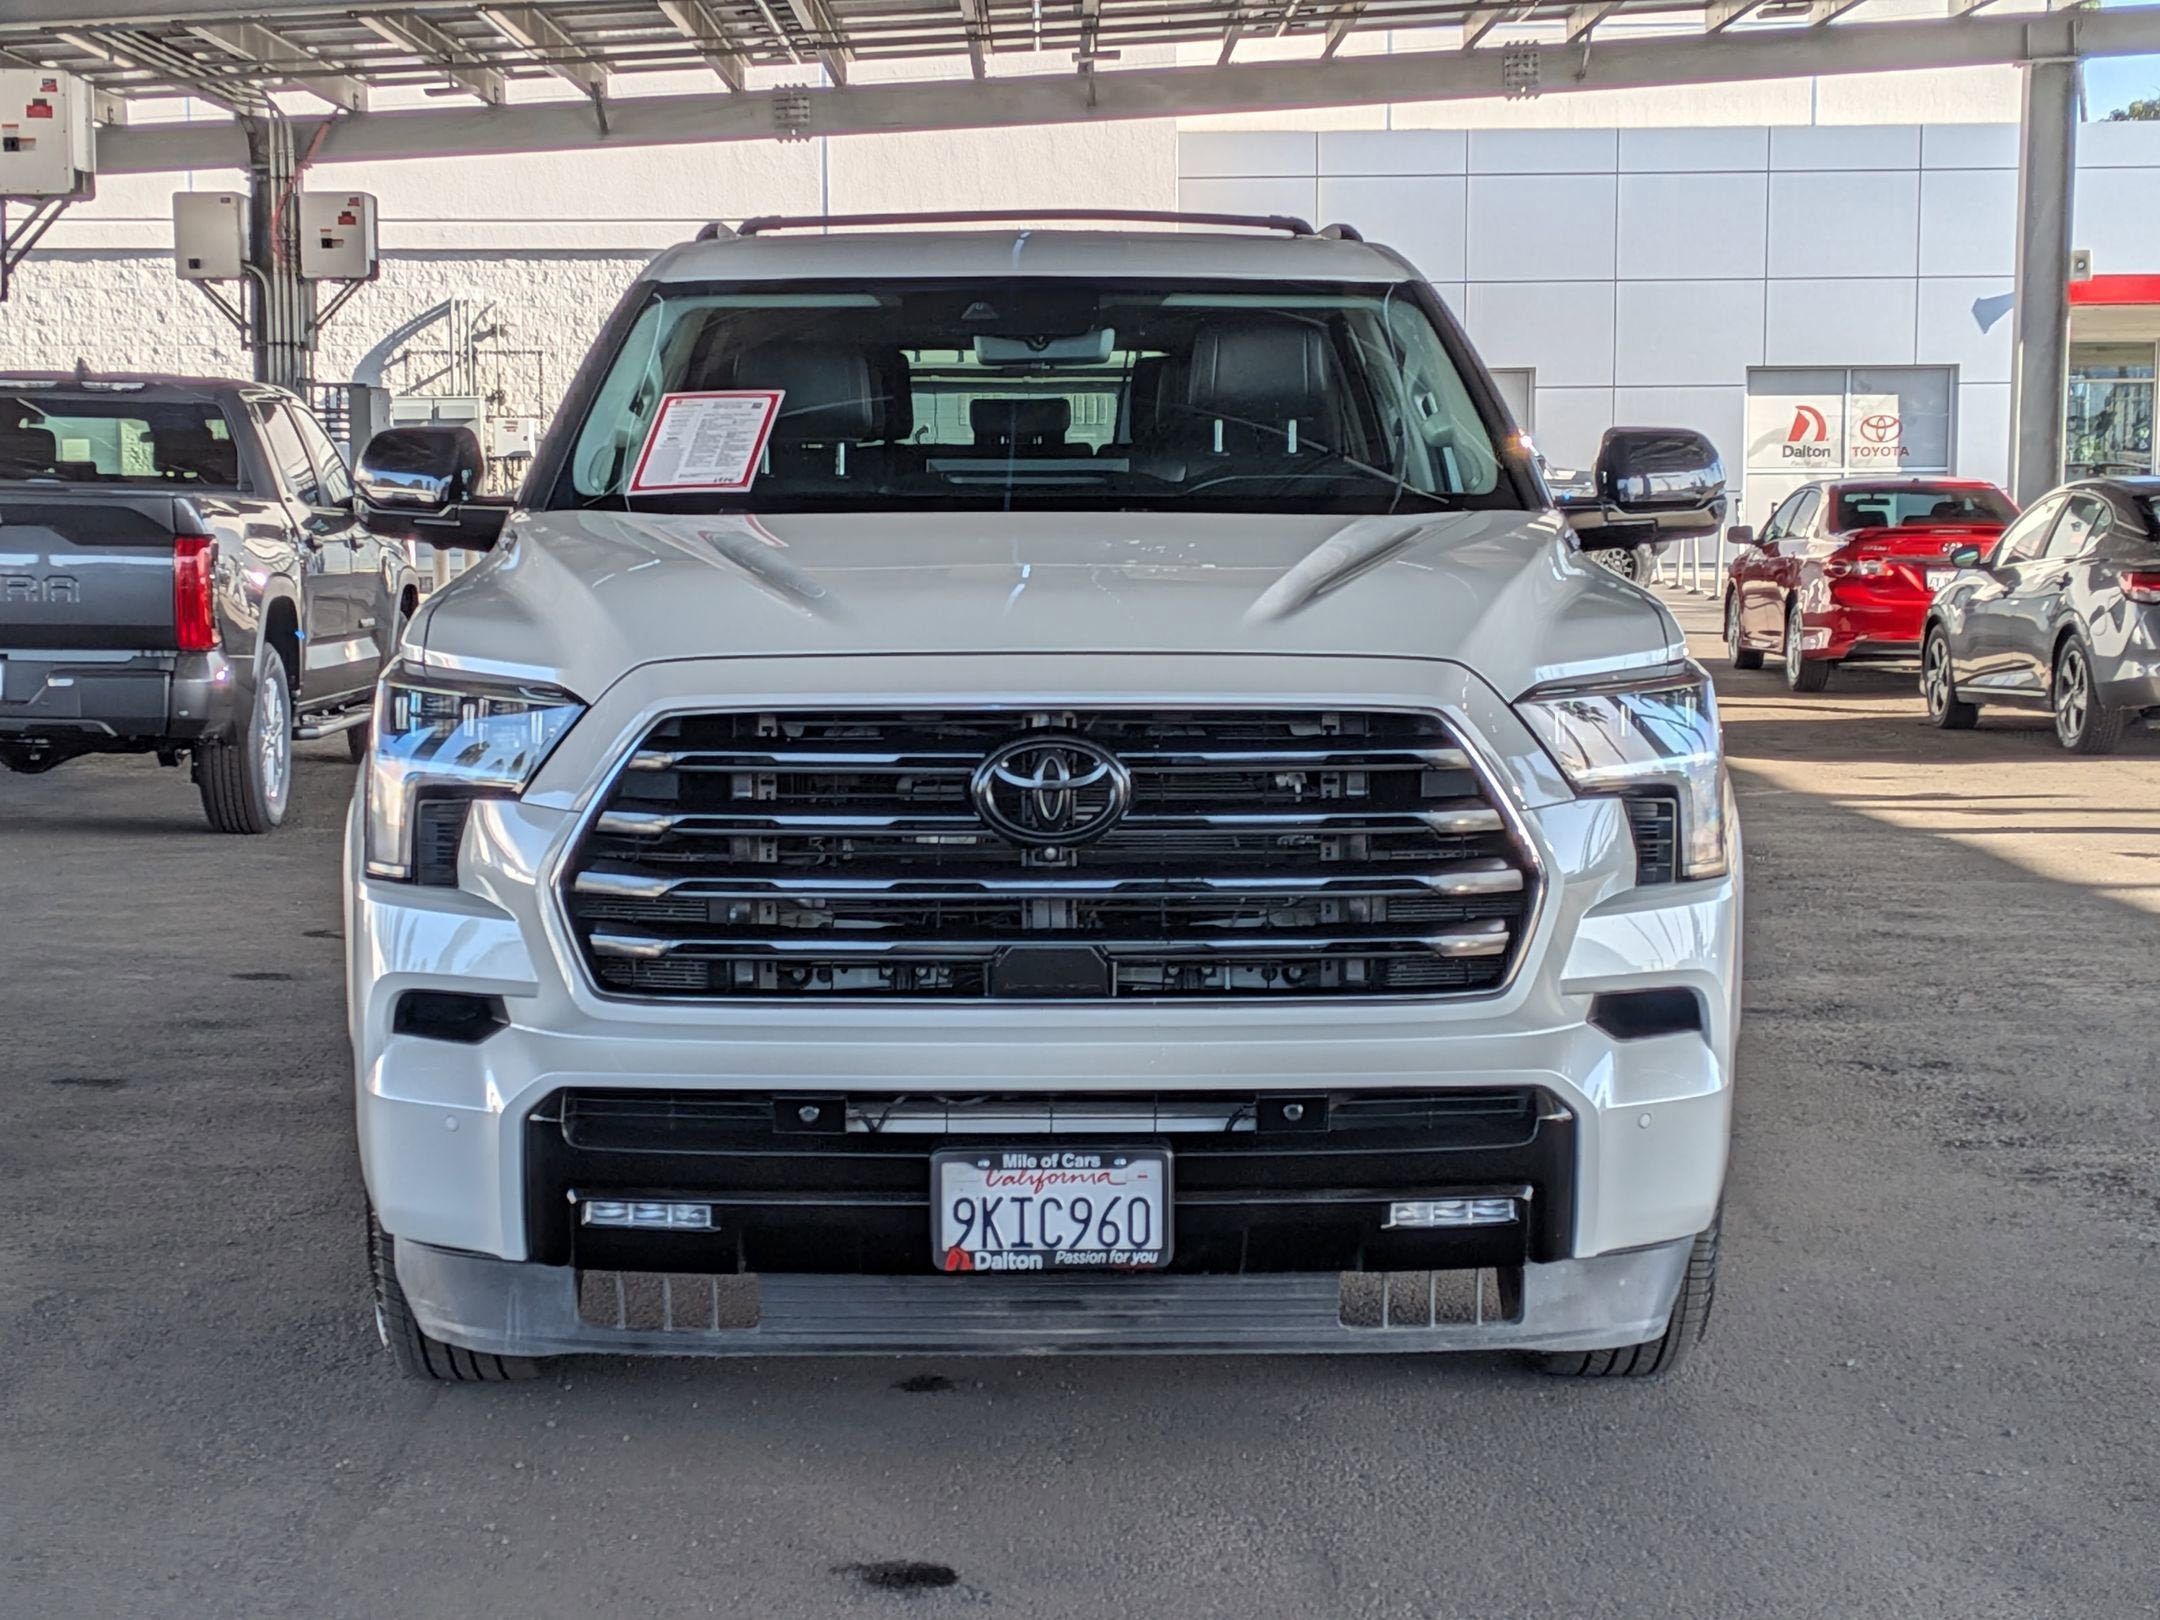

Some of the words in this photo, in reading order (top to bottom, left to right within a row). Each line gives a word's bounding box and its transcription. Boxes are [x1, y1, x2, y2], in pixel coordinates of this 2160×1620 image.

[1782, 445, 1831, 458] Dalton
[1852, 447, 1910, 457] TOYOTA
[1002, 1154, 1037, 1168] Mile
[1040, 1153, 1059, 1168] of
[1061, 1153, 1101, 1168] Cars
[985, 1169, 1127, 1194] California
[953, 1196, 1150, 1248] 9KIC960
[975, 1252, 1043, 1270] Dalton
[1055, 1251, 1106, 1265] Passion
[1109, 1250, 1129, 1264] for
[1131, 1251, 1158, 1266] you
